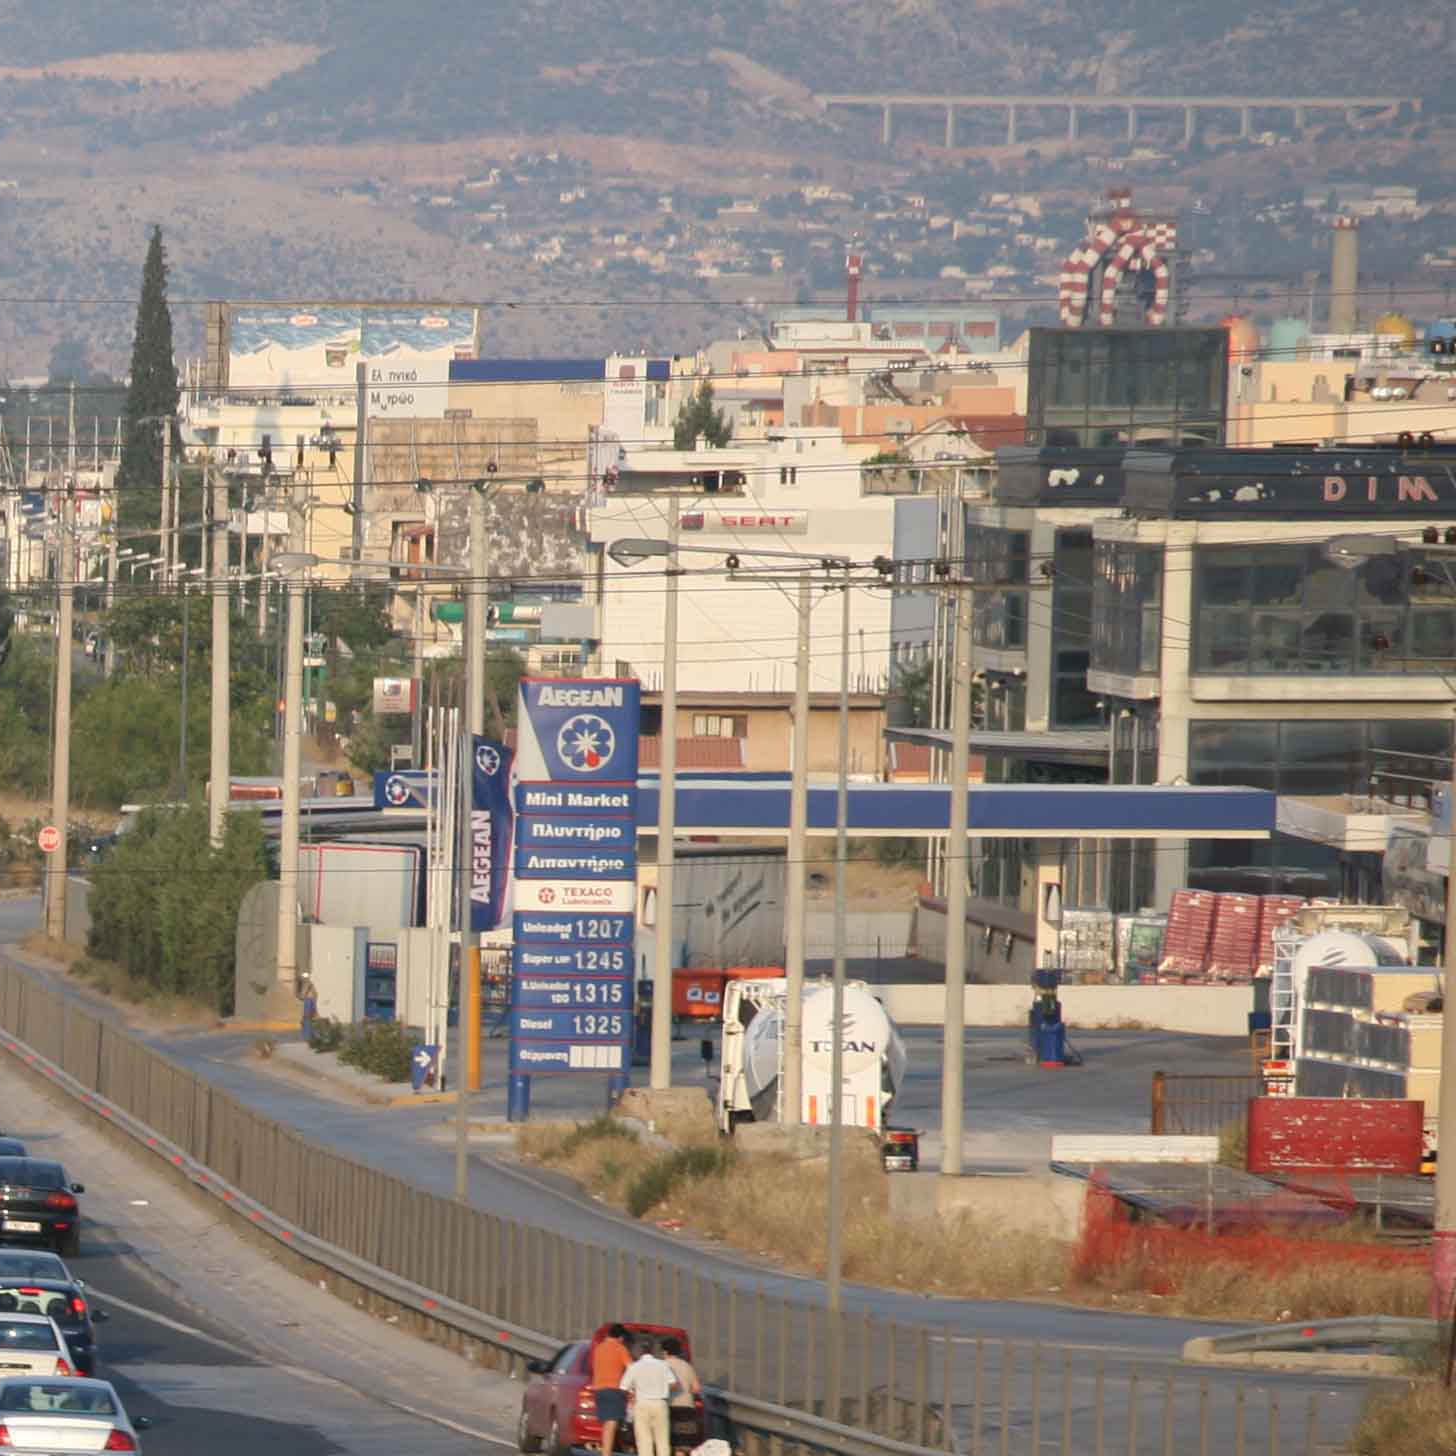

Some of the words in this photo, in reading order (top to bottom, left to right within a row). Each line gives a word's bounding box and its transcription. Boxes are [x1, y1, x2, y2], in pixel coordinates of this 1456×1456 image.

[721, 515, 796, 528] SEAT
[537, 685, 624, 708] AEGEAN
[526, 792, 563, 807] Mini
[567, 792, 630, 808] Market
[532, 821, 622, 840] Πλυντήριο
[470, 810, 490, 904] AEGEAN
[563, 887, 613, 897] TEXACO
[520, 1018, 553, 1030] Diesel
